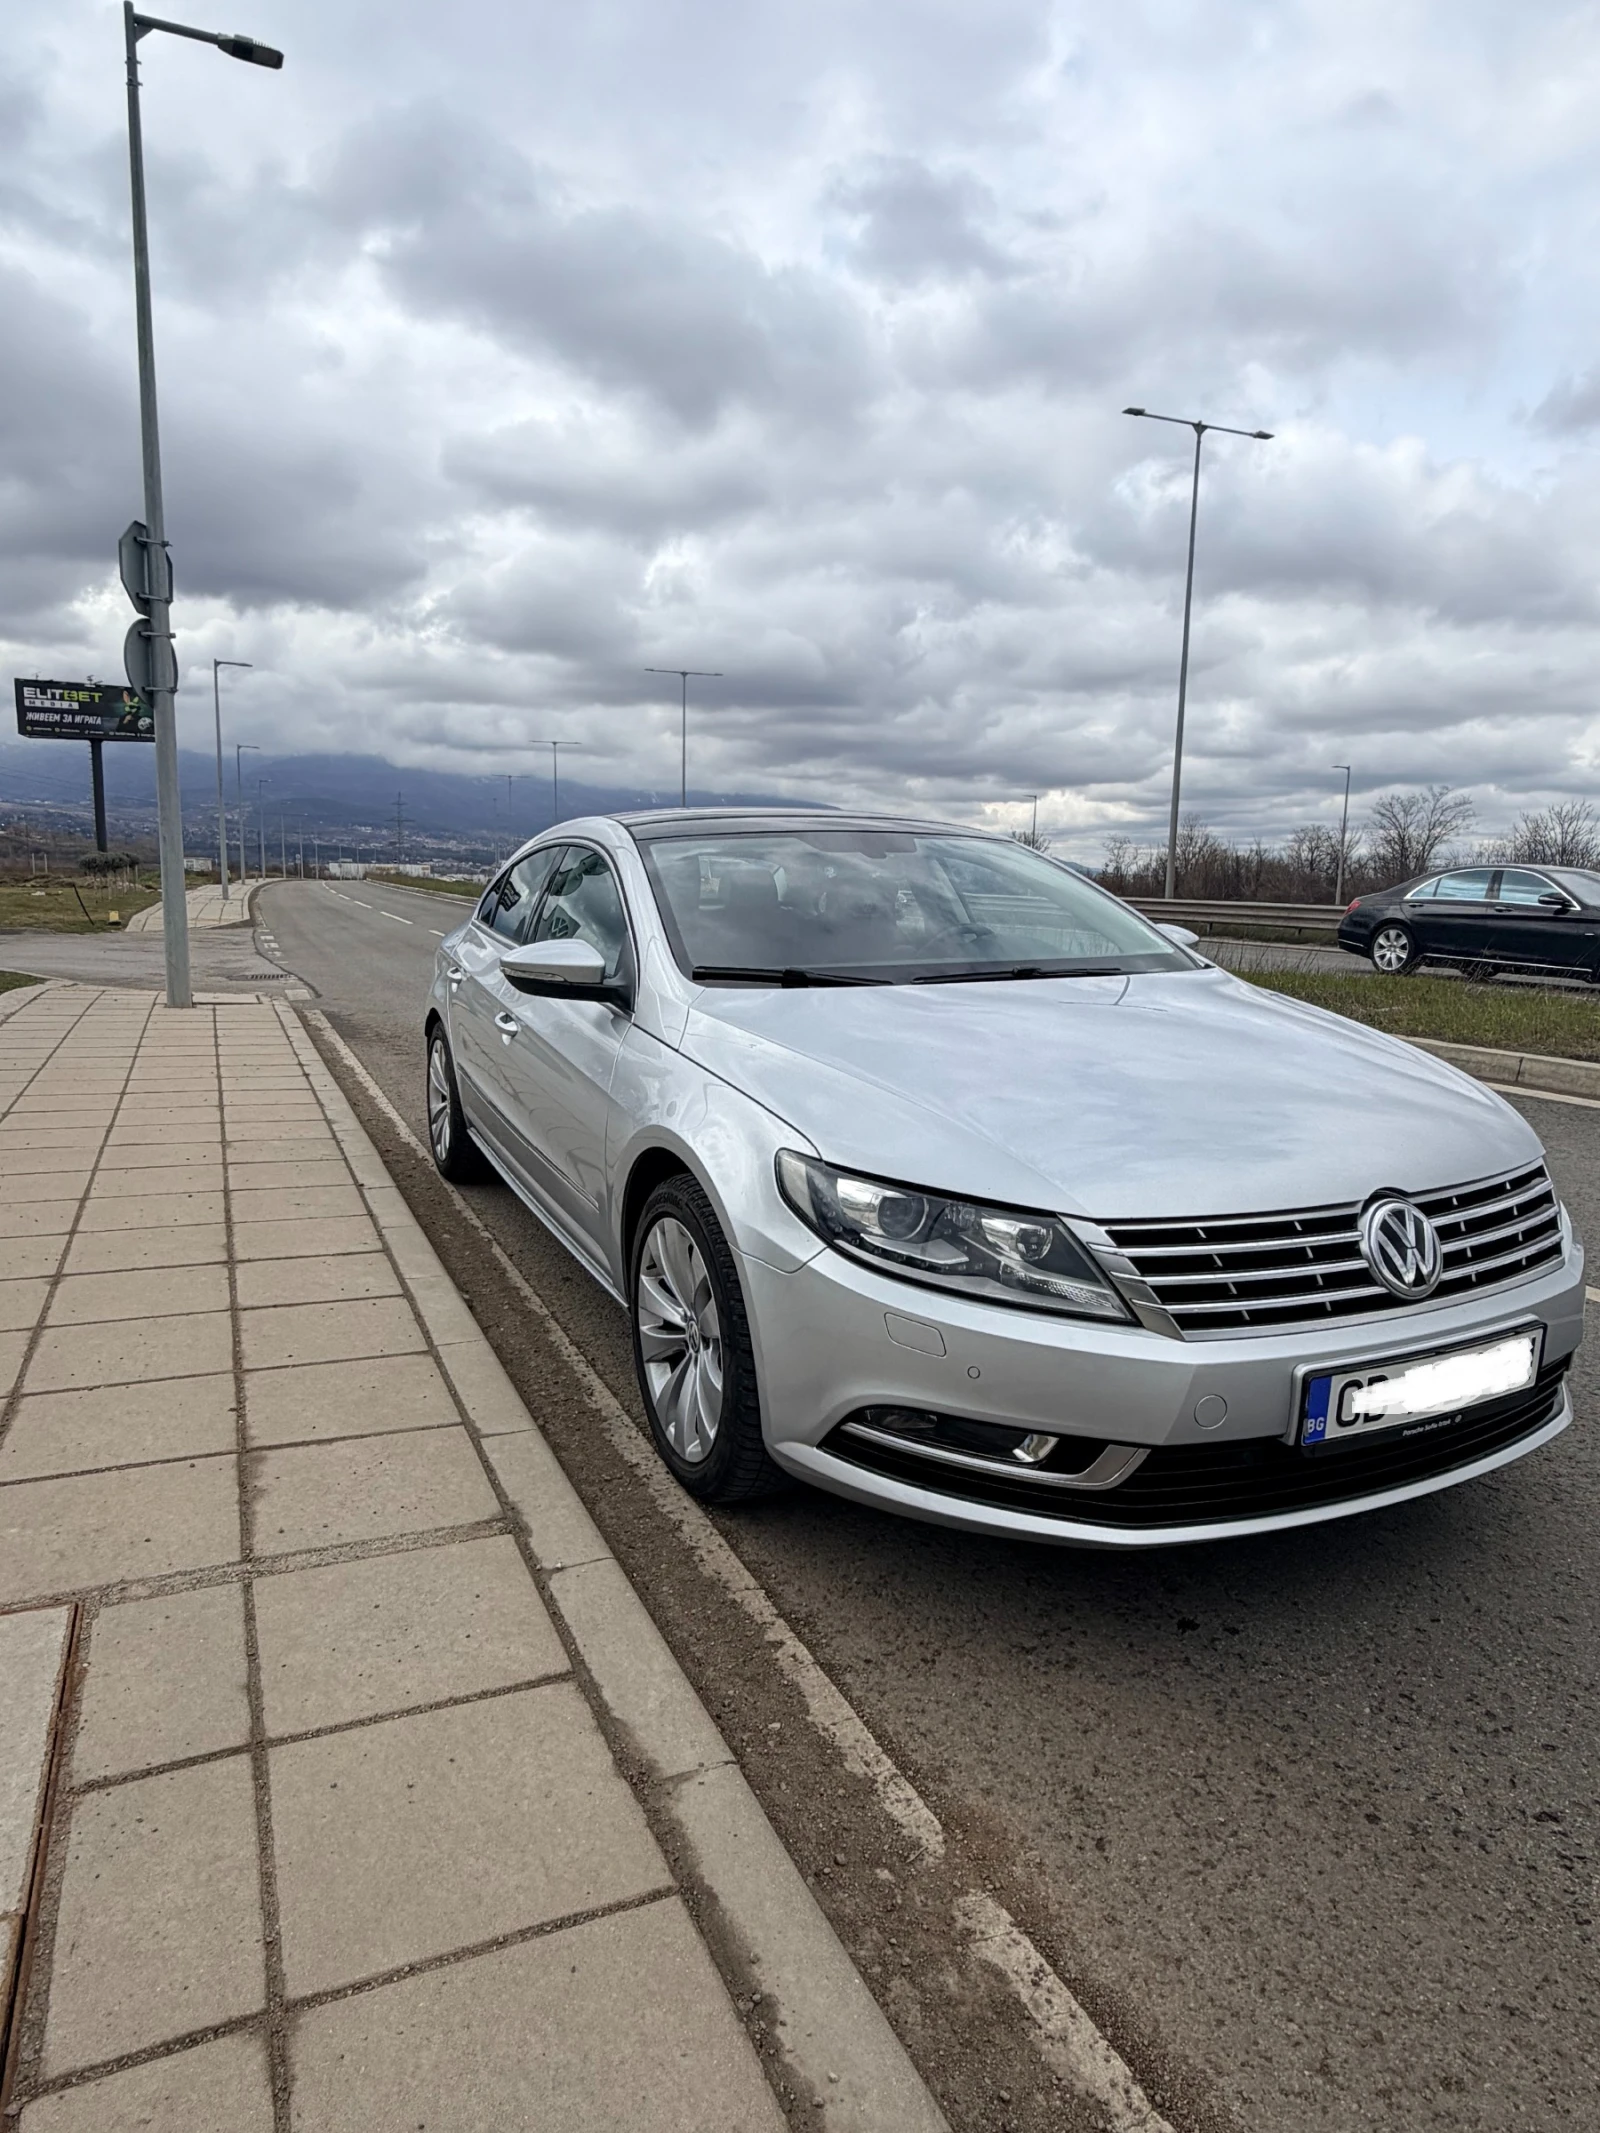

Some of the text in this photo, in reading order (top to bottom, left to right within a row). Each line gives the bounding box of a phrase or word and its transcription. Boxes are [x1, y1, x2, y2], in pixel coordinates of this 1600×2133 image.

[23, 687, 102, 703] ELITBET
[26, 712, 101, 725] ЖИВЕЕМ ЗА ИГРАТА
[1372, 1204, 1437, 1292] VW
[1307, 1416, 1325, 1433] BG
